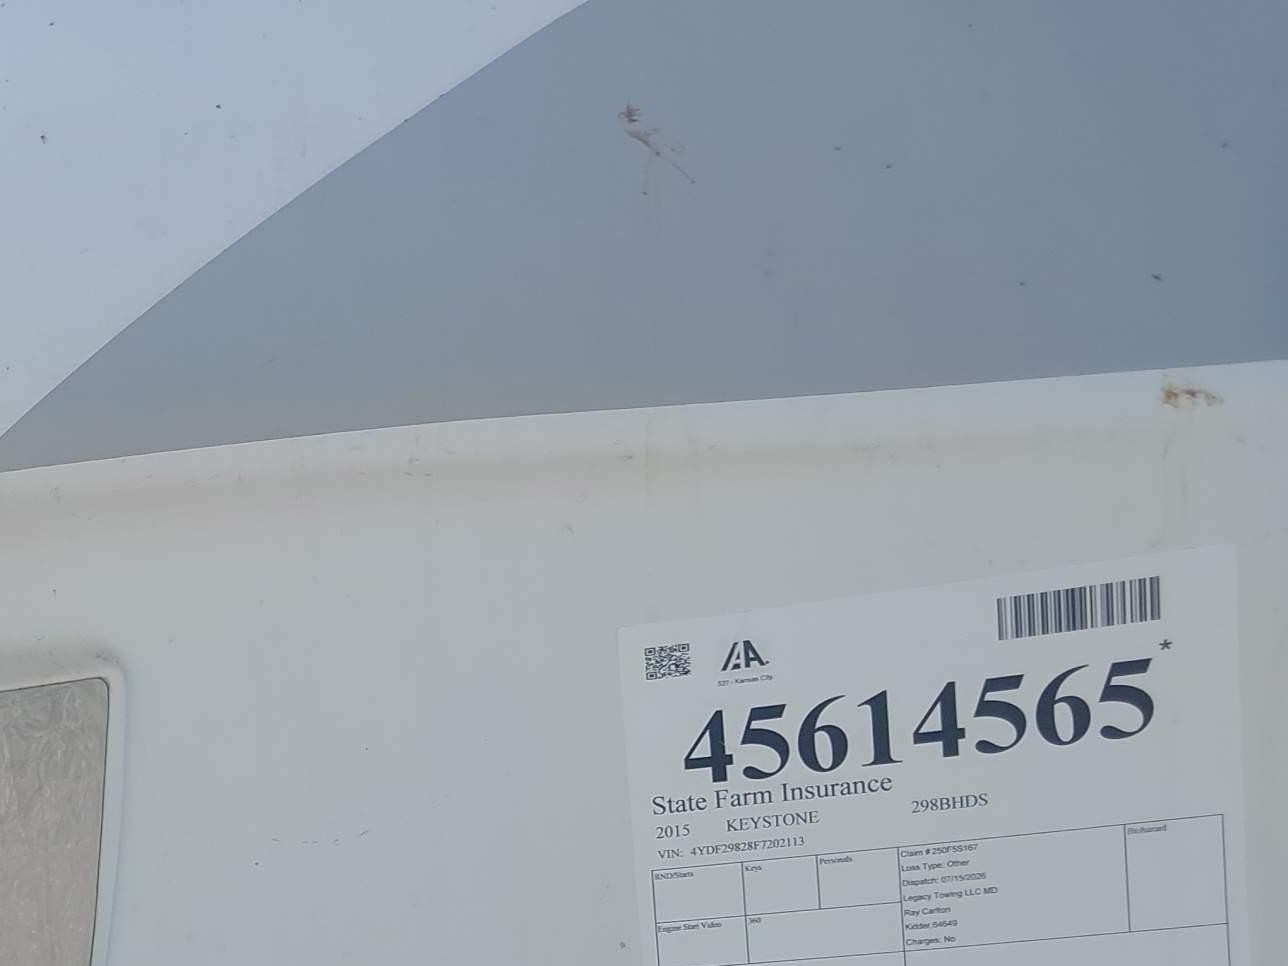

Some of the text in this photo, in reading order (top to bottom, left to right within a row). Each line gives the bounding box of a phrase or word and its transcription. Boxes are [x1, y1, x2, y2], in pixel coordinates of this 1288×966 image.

[652, 777, 893, 816] State Farm Insurance
[912, 793, 989, 813] 298BHDS
[656, 810, 820, 839] 2015 KEYSTONE
[657, 848, 684, 860] VIN:
[900, 850, 924, 858] Claim
[744, 865, 763, 873] Keys
[901, 864, 921, 872] Loss
[933, 890, 963, 899] Towing
[964, 887, 982, 896] LLC
[904, 909, 920, 917] Ray
[943, 935, 957, 943] No
